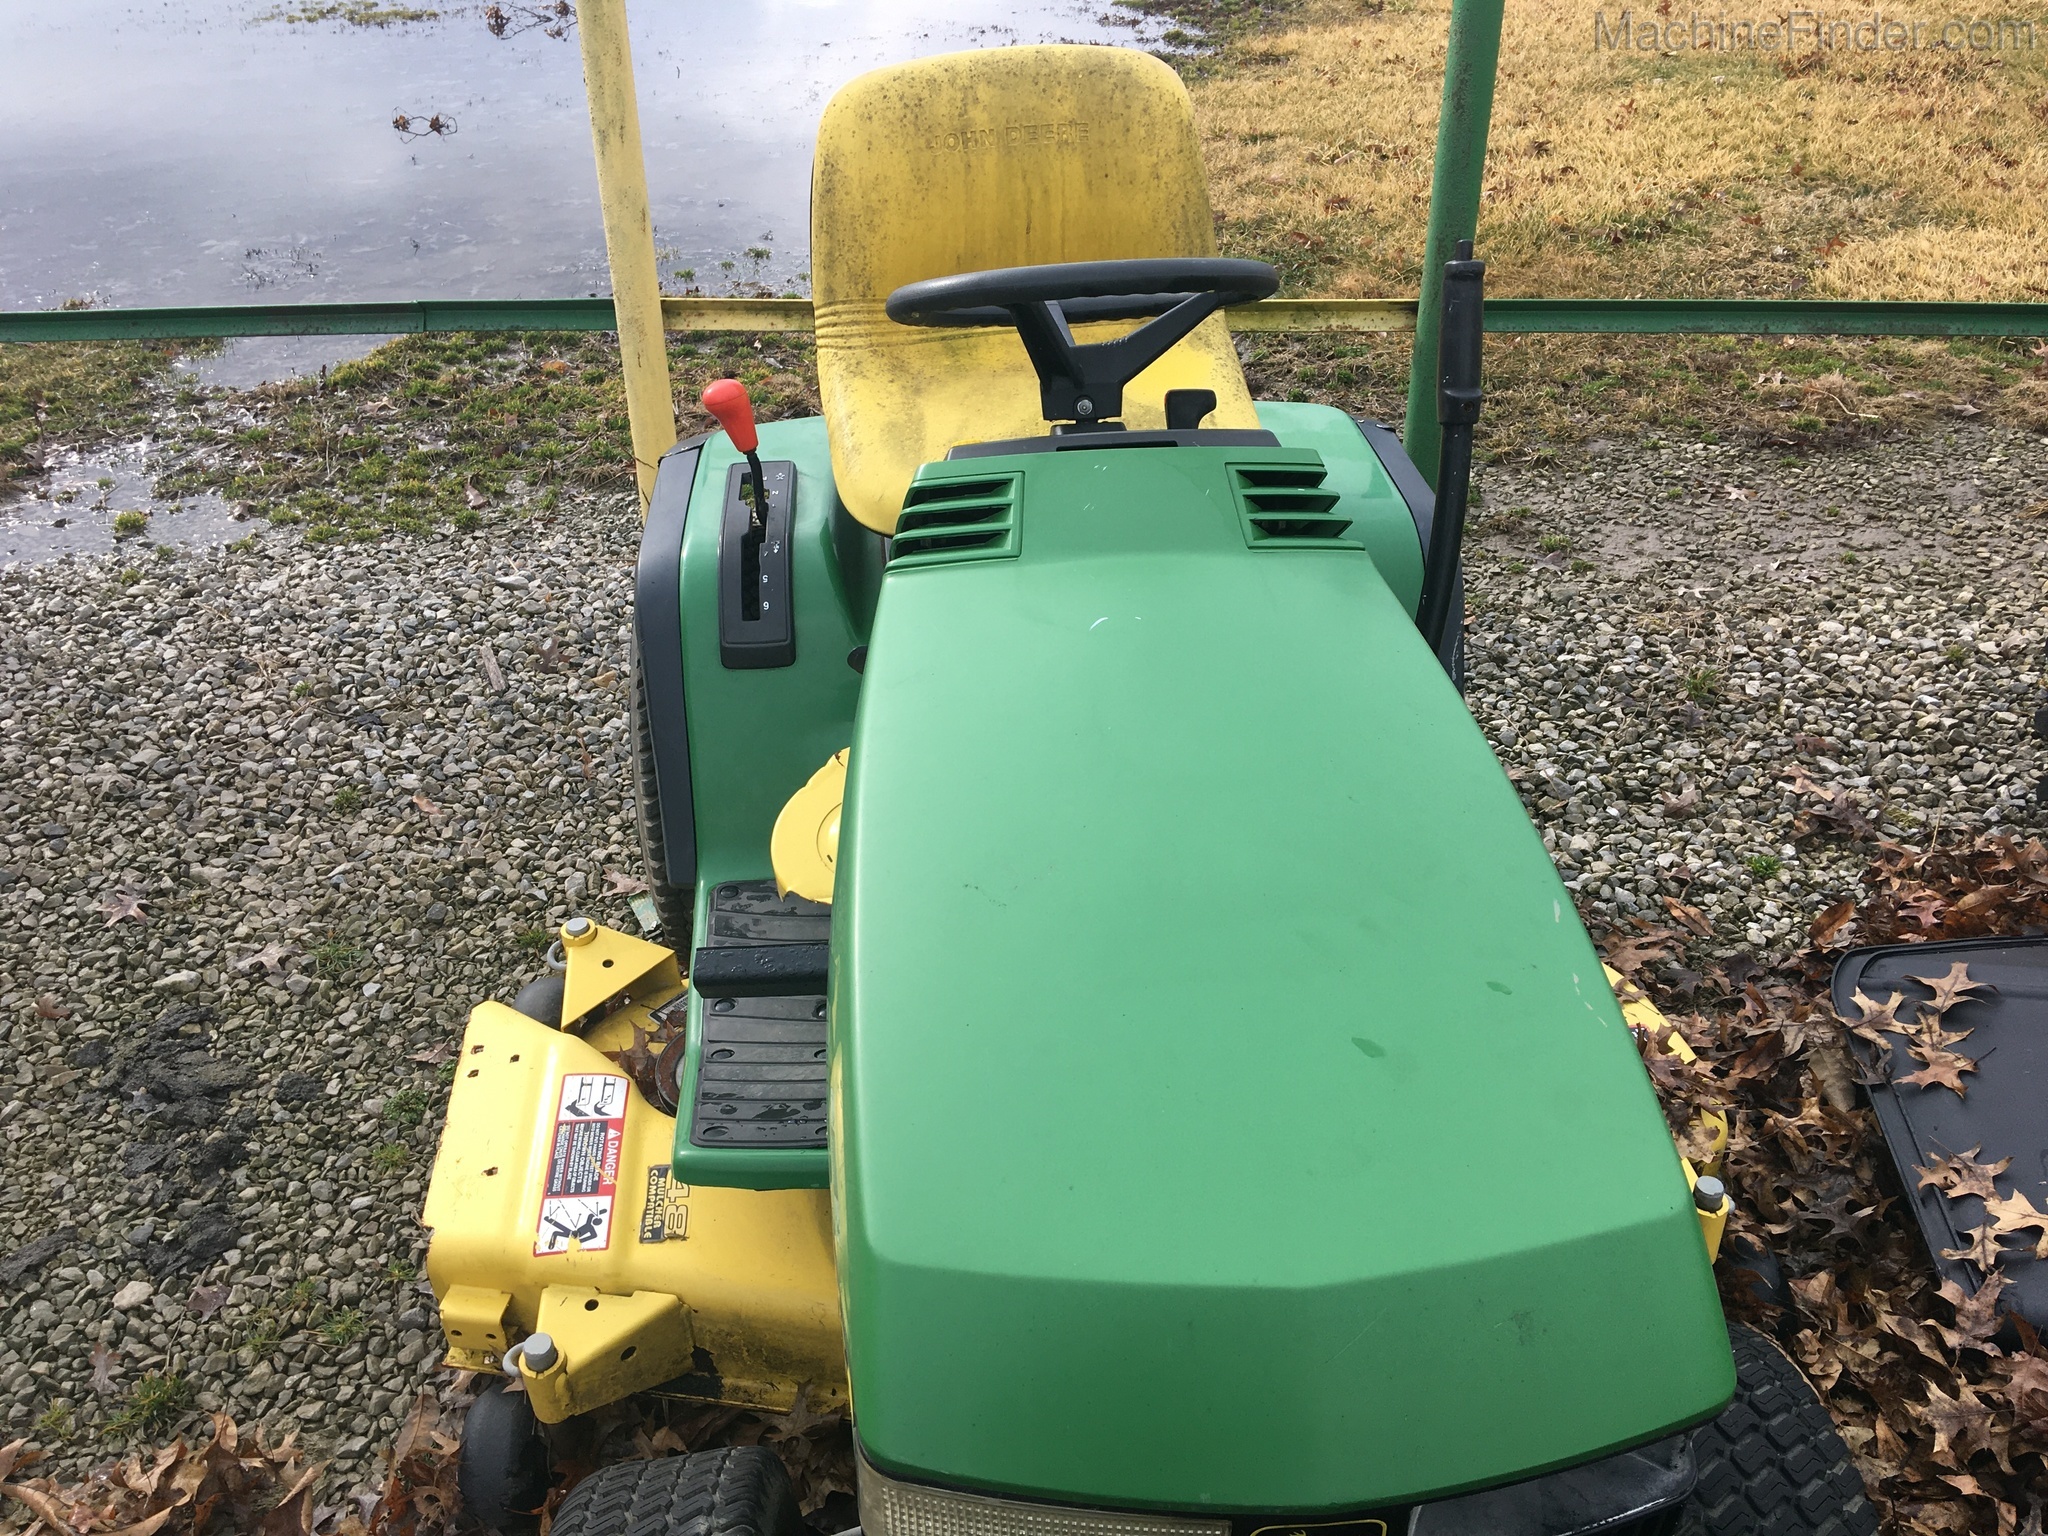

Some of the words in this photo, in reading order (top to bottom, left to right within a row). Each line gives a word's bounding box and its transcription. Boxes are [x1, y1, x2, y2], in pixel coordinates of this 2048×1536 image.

[928, 129, 996, 155] JOHN
[1005, 123, 1089, 147] DEERE
[580, 1131, 589, 1155] THROWN
[596, 1132, 604, 1160] ROTATING
[602, 1140, 618, 1184] DANGER
[576, 1157, 585, 1183] OBJECTS
[643, 1169, 659, 1239] COMPATIBLE
[653, 1177, 666, 1229] MULCHER
[663, 1168, 691, 1238] 48
